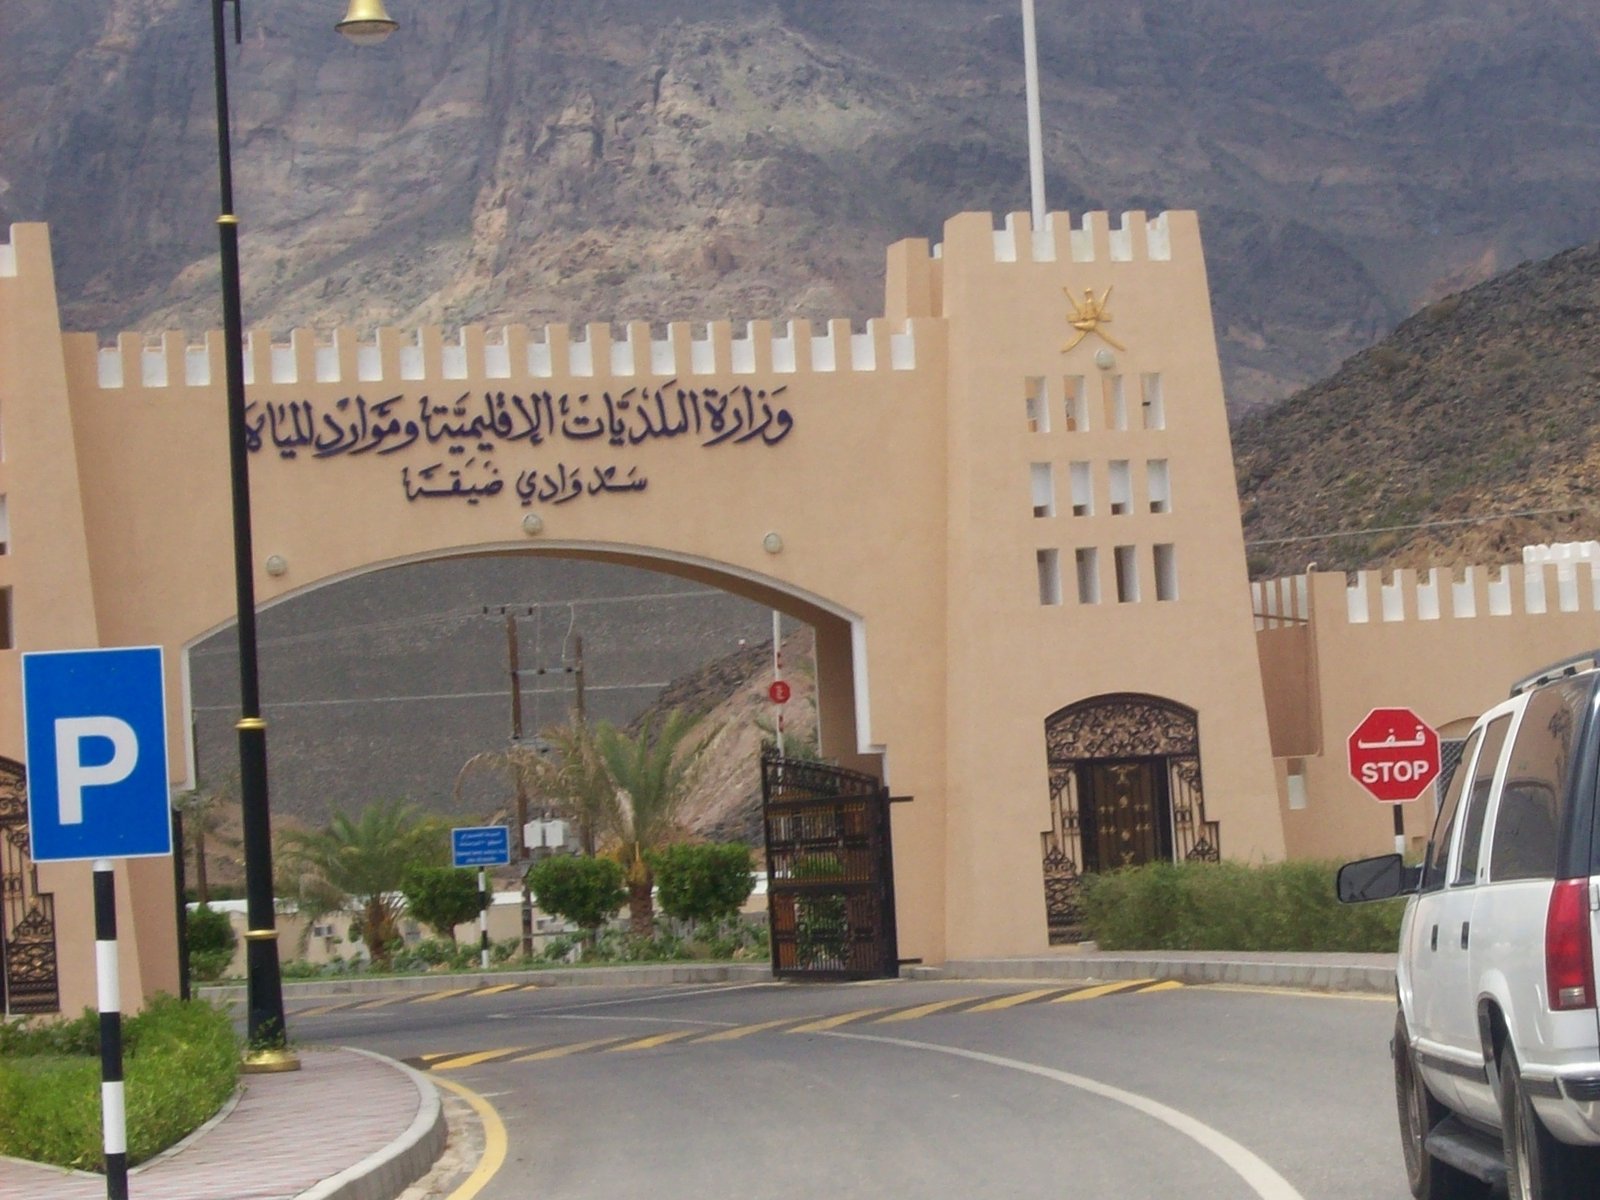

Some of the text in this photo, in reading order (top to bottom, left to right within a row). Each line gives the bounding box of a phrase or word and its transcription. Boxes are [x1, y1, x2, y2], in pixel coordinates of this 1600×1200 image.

[701, 384, 793, 447] وزارة
[515, 462, 583, 507] وادي
[588, 465, 648, 496] سد
[1357, 725, 1426, 750] قف
[54, 716, 139, 825] P
[1361, 760, 1429, 784] STOP
